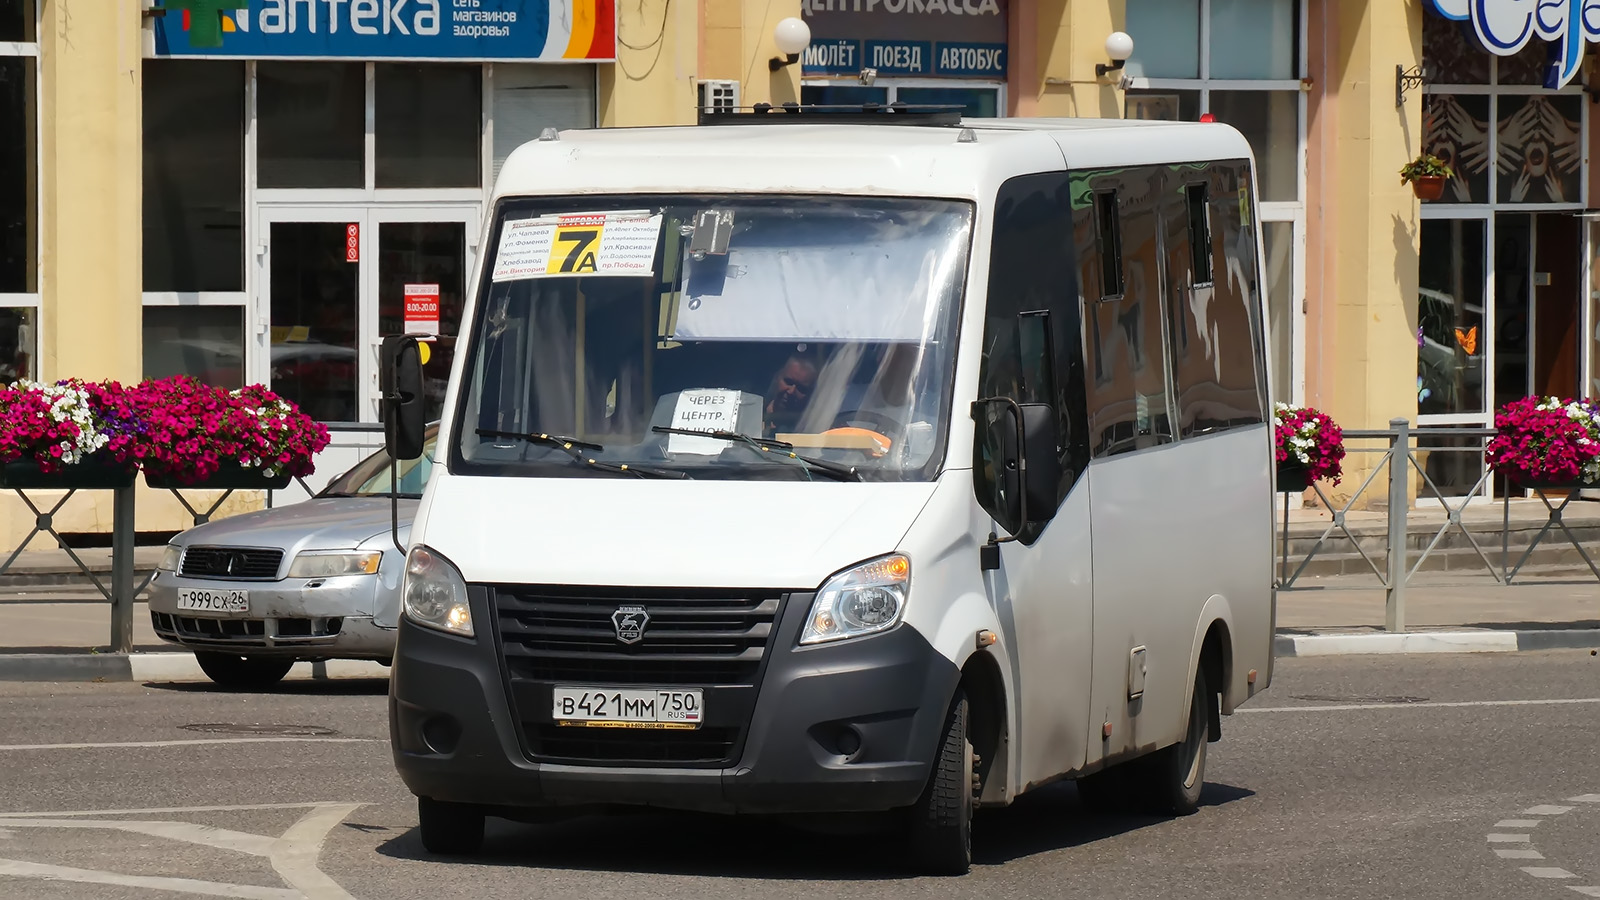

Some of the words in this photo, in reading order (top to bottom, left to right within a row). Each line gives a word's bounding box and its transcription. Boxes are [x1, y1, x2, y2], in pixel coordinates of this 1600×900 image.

[259, 0, 440, 36] аптека
[452, 10, 517, 22] магазинов
[453, 25, 510, 39] здоровья
[873, 45, 922, 72] ПОЕЗД
[940, 47, 1003, 70] АВТОБУС
[689, 396, 726, 405] ЧЕРЕЗ
[681, 411, 726, 421] ЦЕНТР.
[659, 693, 695, 711] 750
[667, 711, 685, 719] RUS
